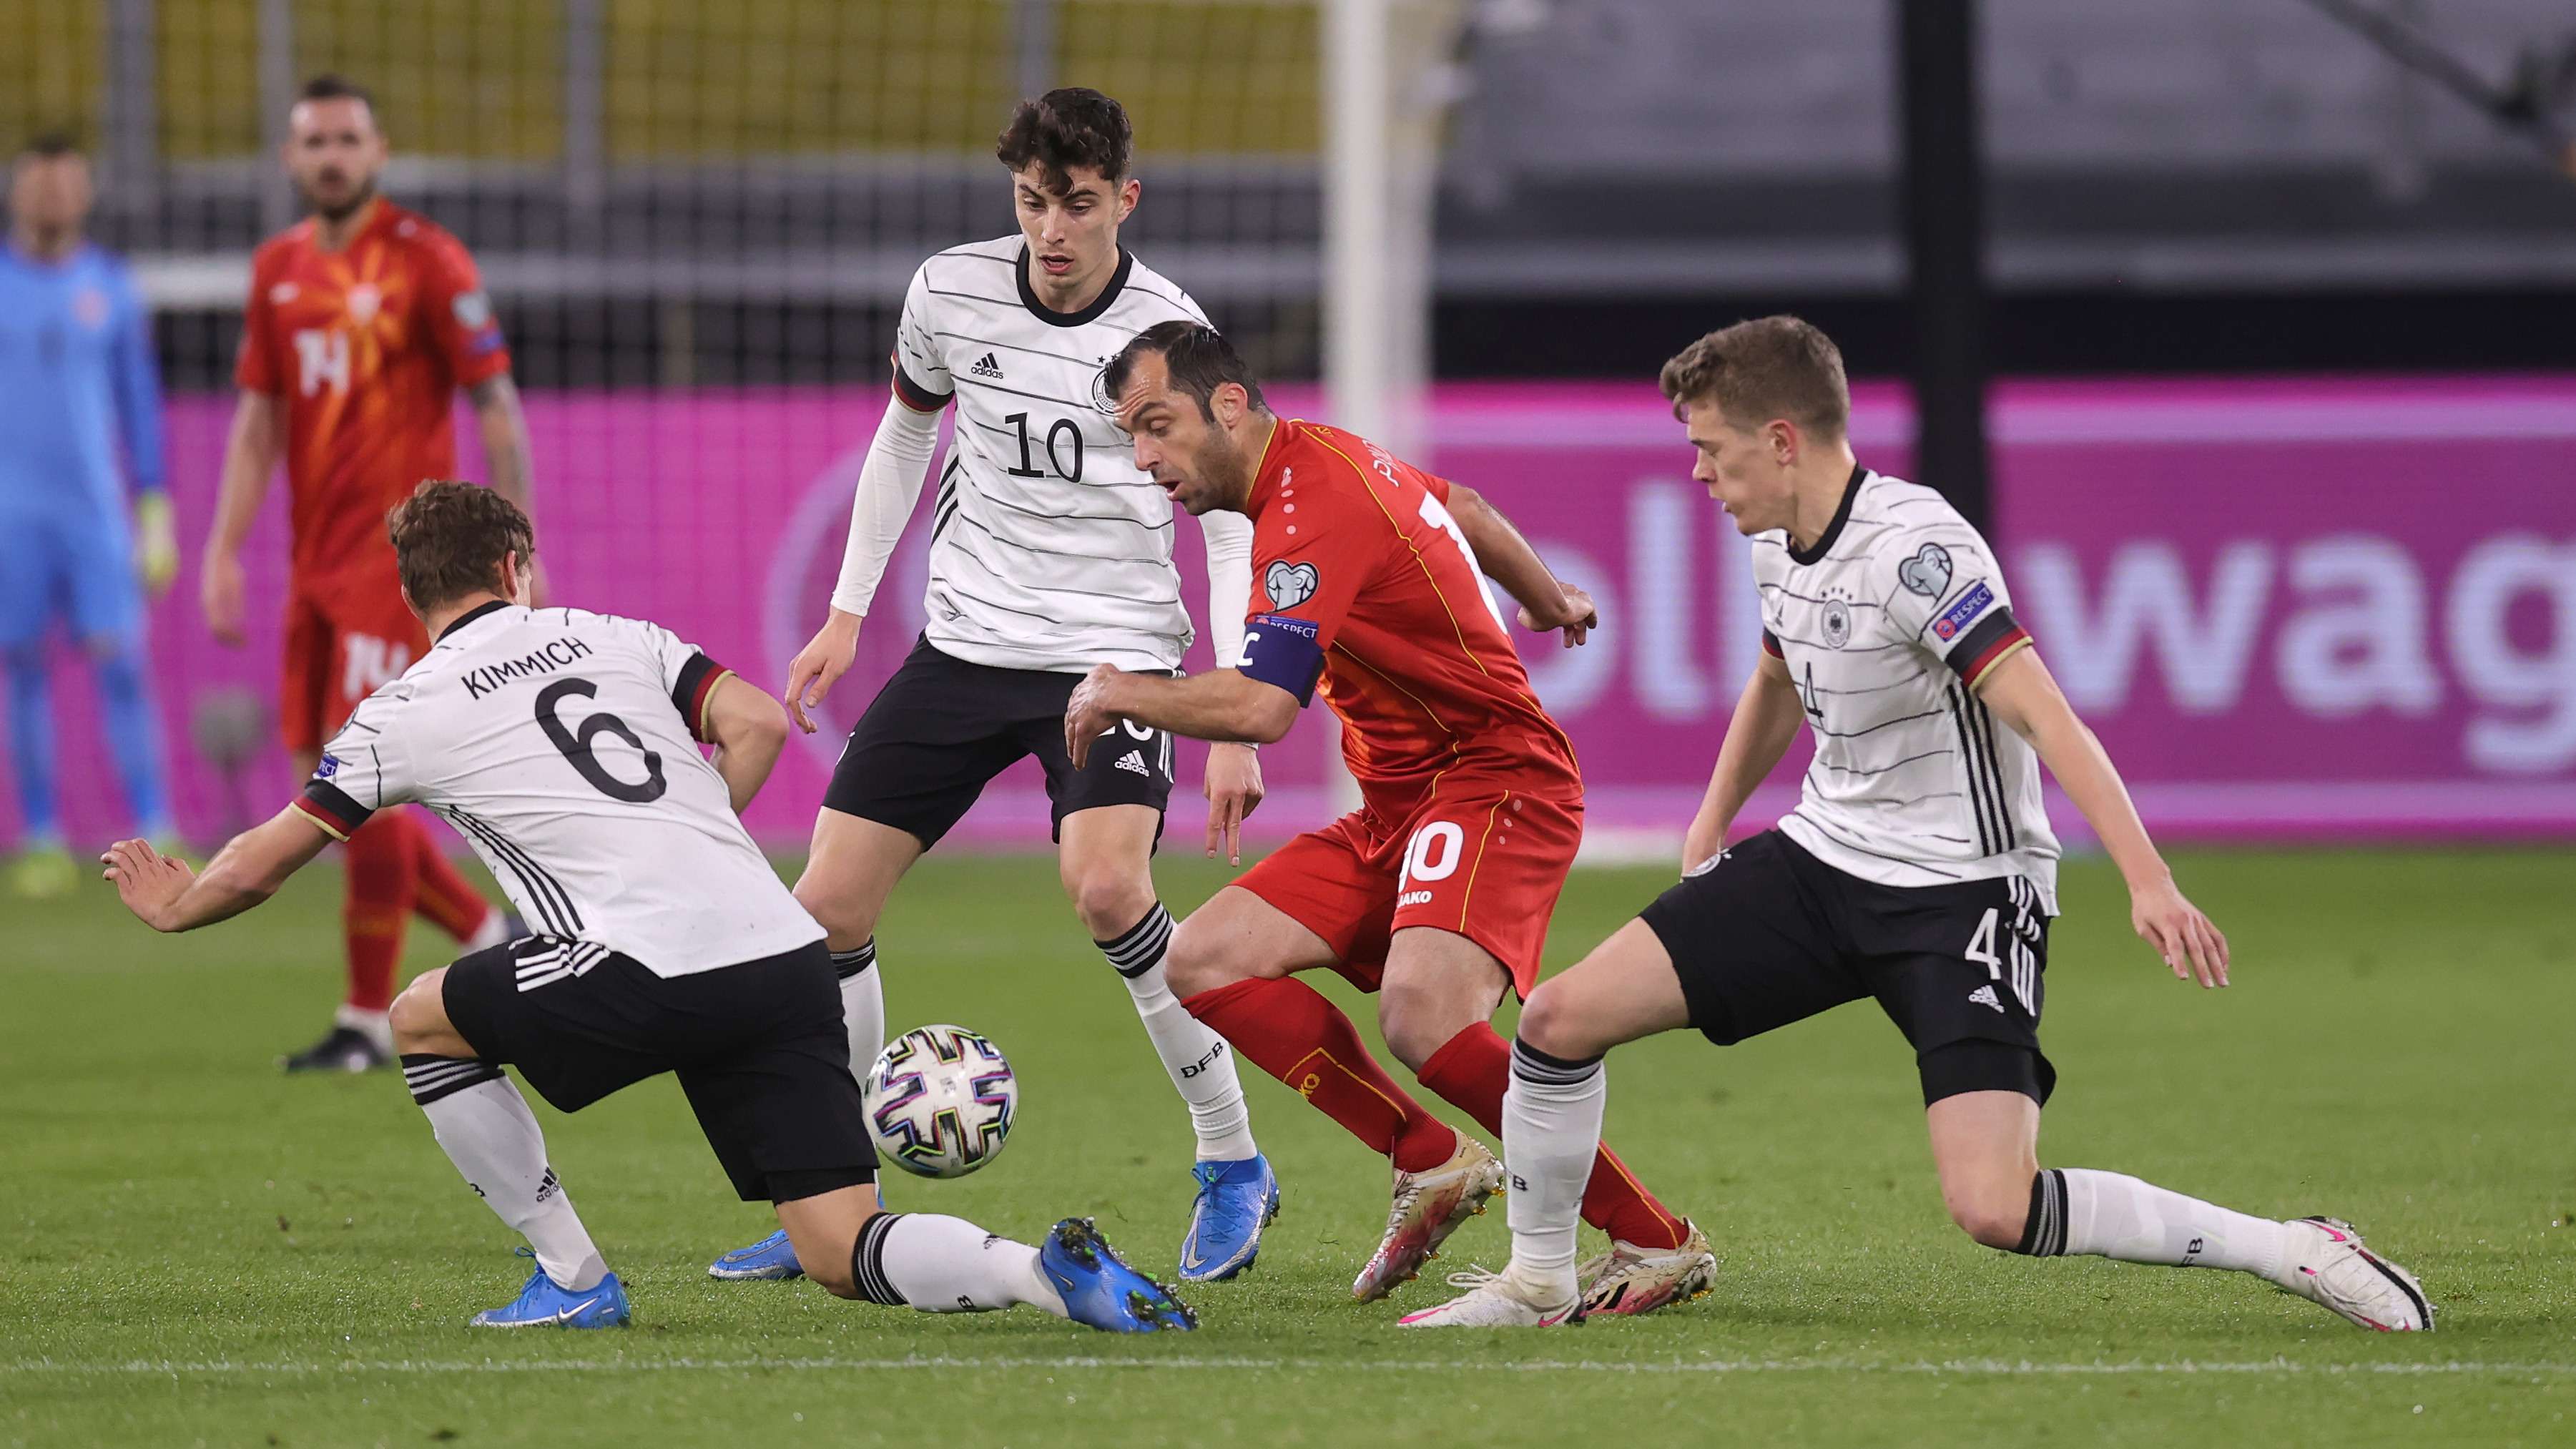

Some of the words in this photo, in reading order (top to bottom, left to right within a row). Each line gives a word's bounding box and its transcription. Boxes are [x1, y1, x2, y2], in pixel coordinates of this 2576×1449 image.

[292, 329, 349, 396] 14
[970, 365, 1003, 379] adidas
[1005, 412, 1083, 483] 10
[461, 637, 594, 700] KIMMICH
[535, 677, 667, 802] 6
[1114, 761, 1150, 777] adidas
[1965, 908, 2002, 980] 4
[1180, 1041, 1223, 1079] DFB
